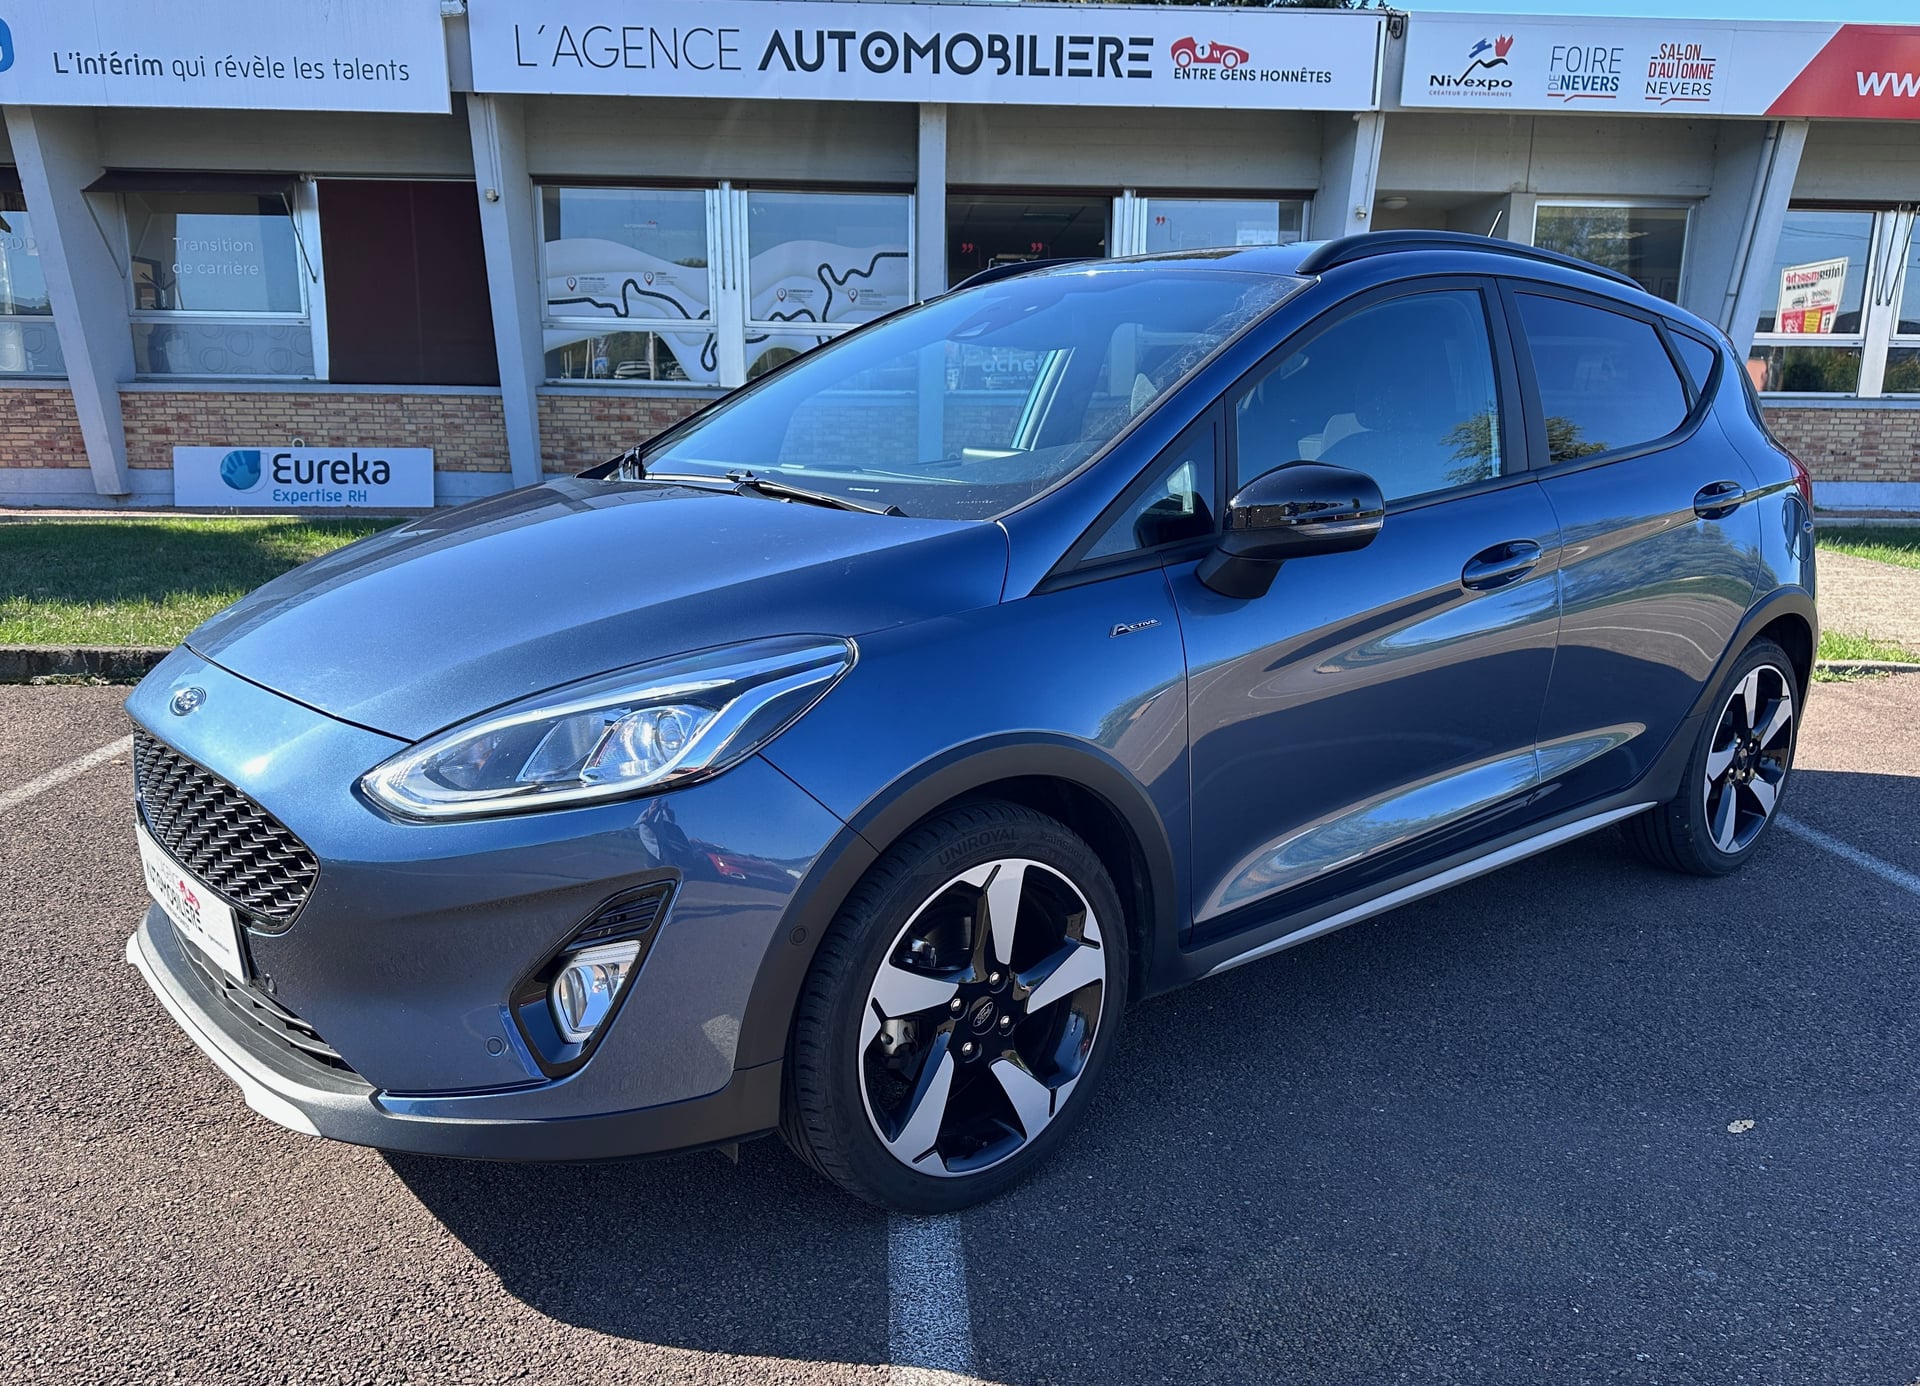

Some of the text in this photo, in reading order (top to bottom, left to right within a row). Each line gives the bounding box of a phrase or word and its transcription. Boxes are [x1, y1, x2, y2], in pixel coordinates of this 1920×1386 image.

[514, 24, 1154, 78] L'AGENCE AUTOMOBILIERE
[1550, 46, 1624, 74] FOIRE
[1659, 43, 1702, 61] SALON
[53, 51, 410, 82] L'intérim qui révèle les talents
[1174, 67, 1332, 84] ENTRE GENS HONNÊTES
[1648, 58, 1715, 80] D'AUTOMNE
[1429, 67, 1513, 91] Nivexpo
[1548, 75, 1560, 90] DE
[1560, 75, 1620, 92] NEVERS
[1645, 82, 1712, 96] NEVERS
[172, 237, 255, 252] Transition
[172, 260, 259, 275] de carrière
[272, 452, 391, 485] Eureka
[272, 489, 367, 504] Expertise RH
[938, 828, 1020, 866] UNIROYAL
